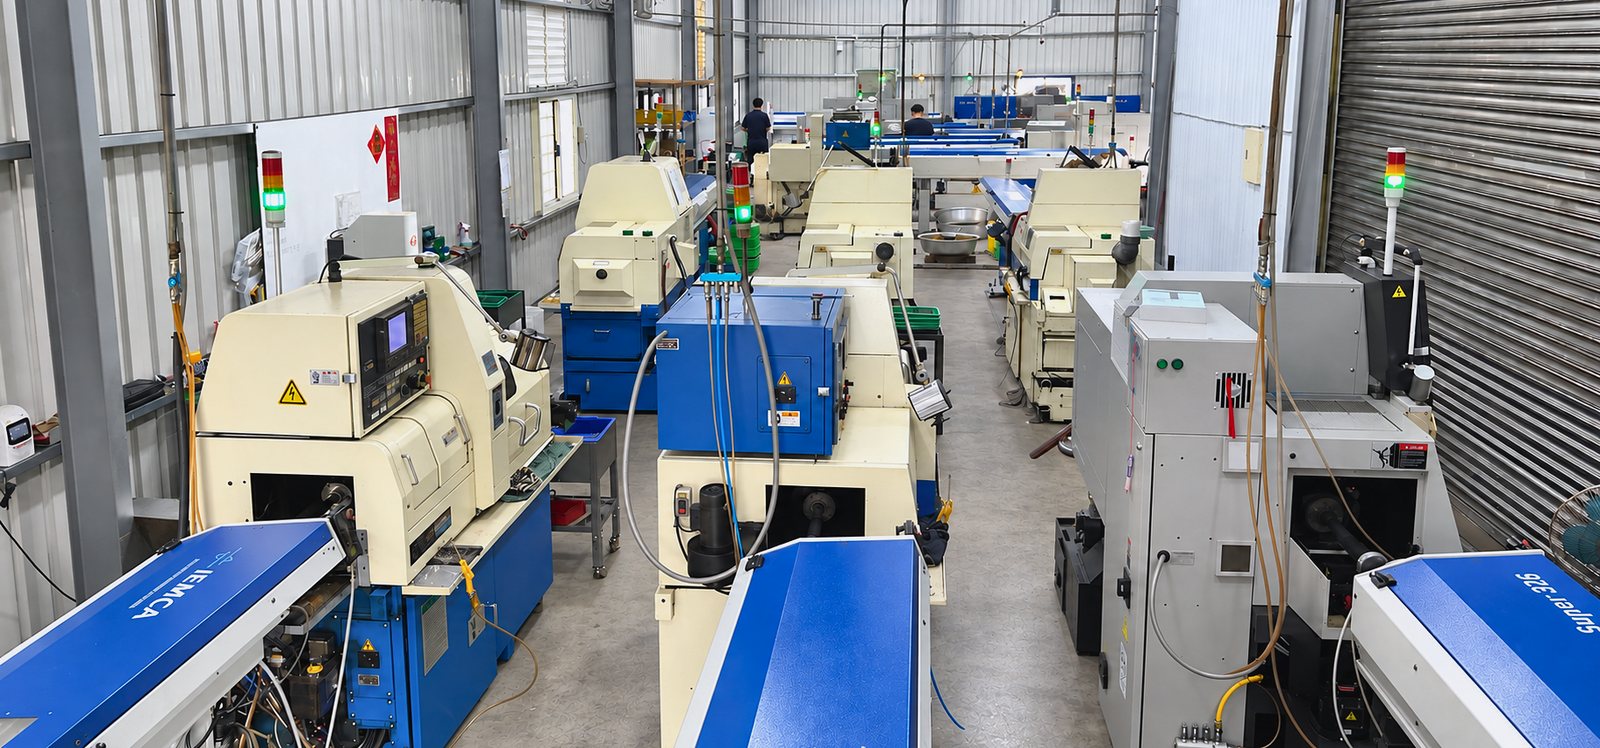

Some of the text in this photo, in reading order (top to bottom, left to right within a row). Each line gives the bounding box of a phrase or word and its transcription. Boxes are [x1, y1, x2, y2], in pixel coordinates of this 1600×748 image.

[131, 569, 214, 620] IEMCA
[1515, 573, 1600, 634] Super 326
